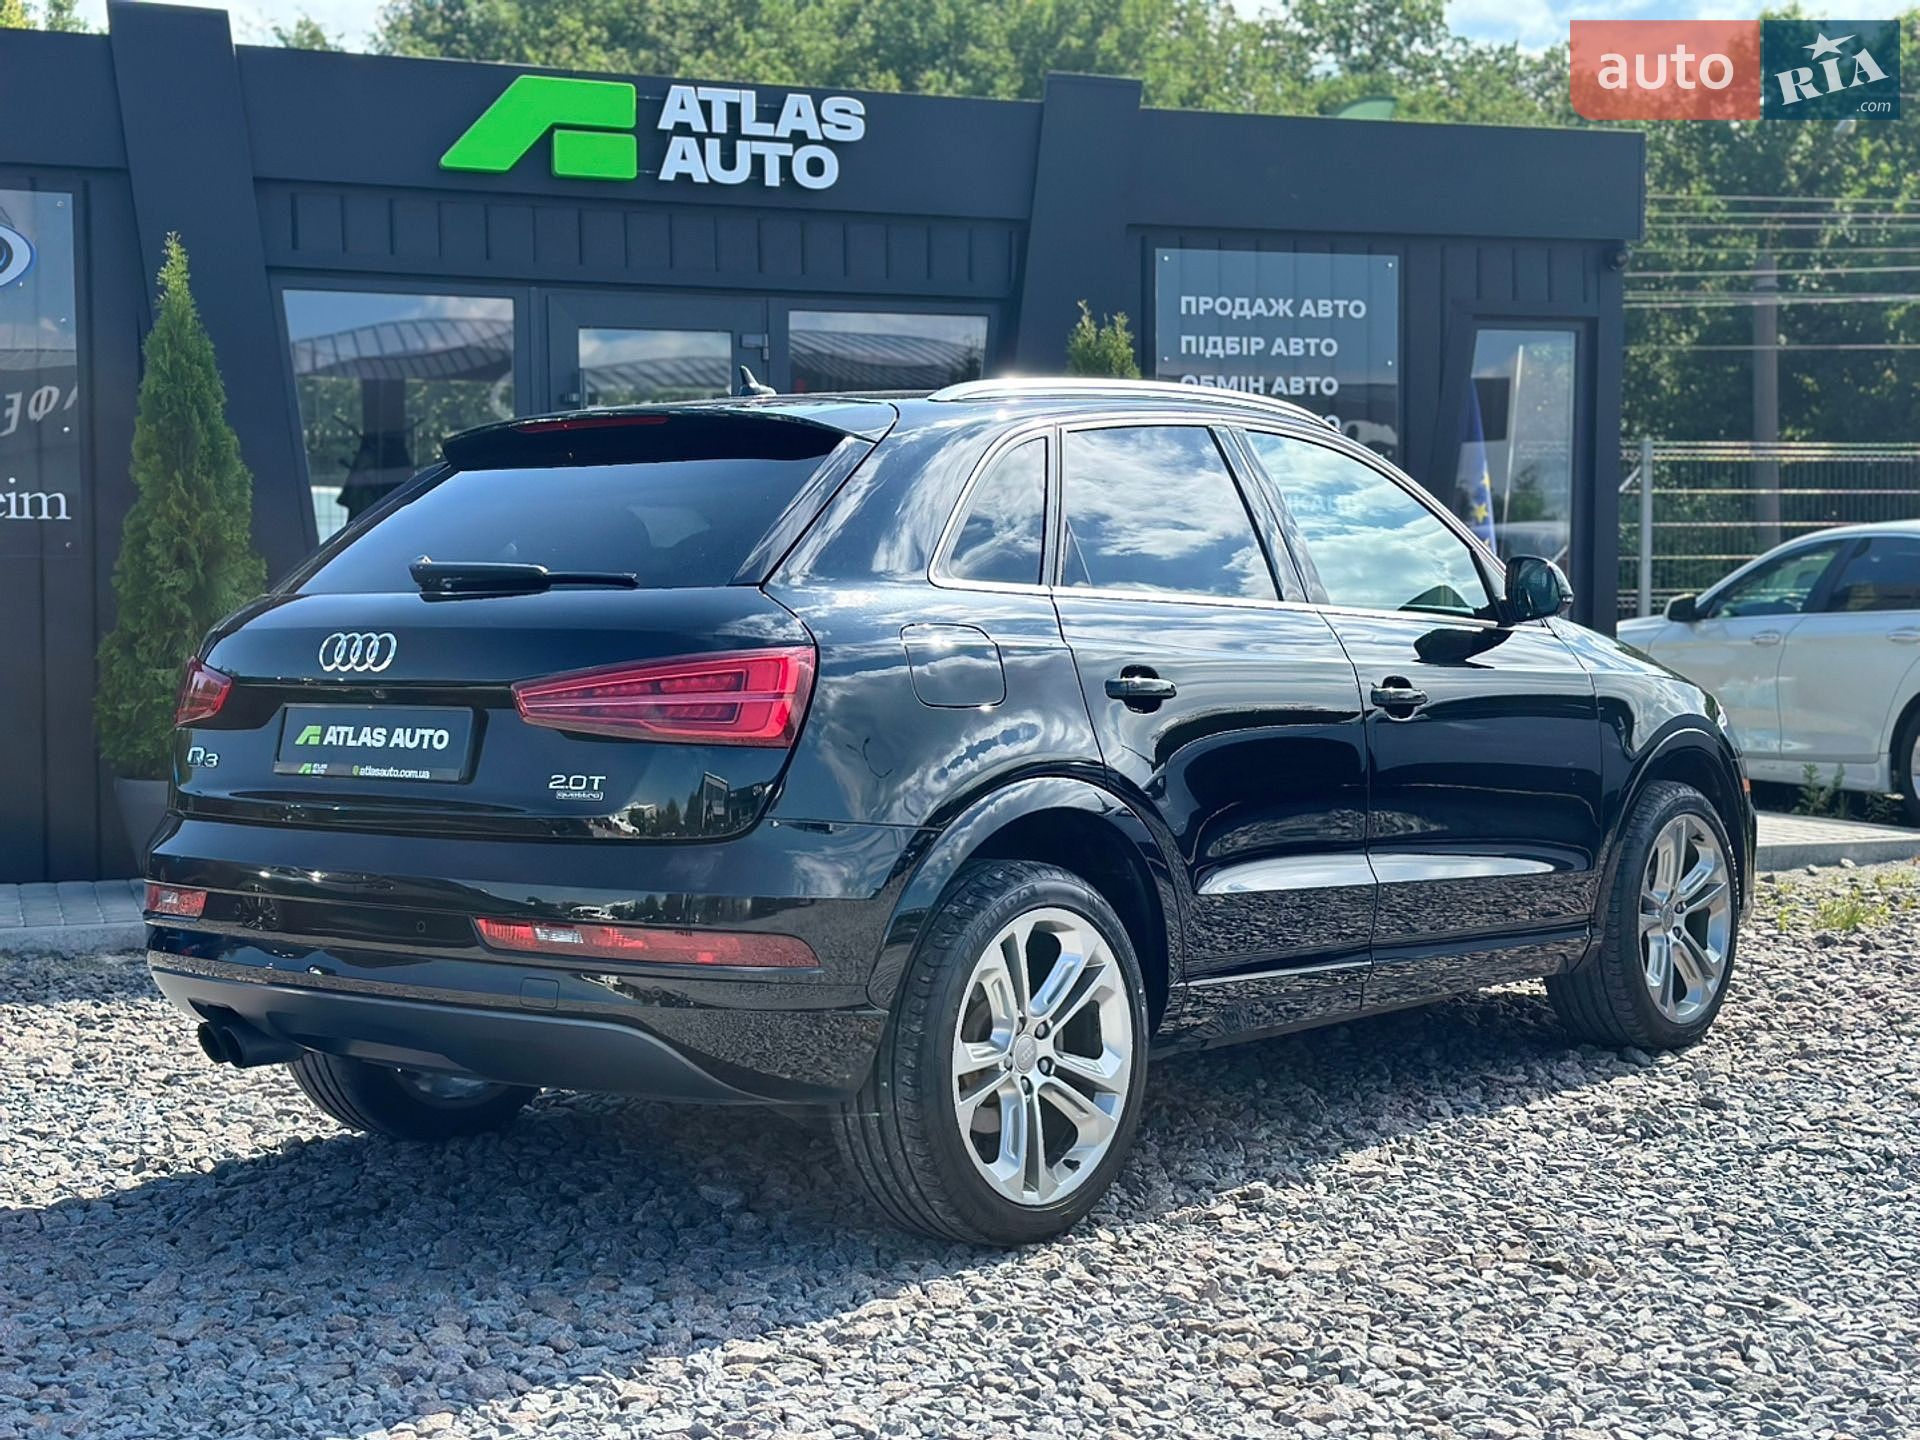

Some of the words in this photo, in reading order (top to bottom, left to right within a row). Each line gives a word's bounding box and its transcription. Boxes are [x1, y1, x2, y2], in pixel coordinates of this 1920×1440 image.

[657, 85, 866, 142] ATLAS
[658, 136, 839, 190] AUTO
[1180, 296, 1293, 320] ПРОДАЖ
[1299, 300, 1367, 318] АВТО
[1180, 335, 1265, 358] ПІДБІР
[1270, 338, 1339, 357] АВТО
[1270, 376, 1339, 396] АВТО
[322, 725, 388, 748] ATLAS
[389, 727, 450, 750] AUTO
[187, 746, 219, 768] Q3
[359, 765, 431, 779] atlasauto.com.ua
[548, 774, 607, 790] 2.0T
